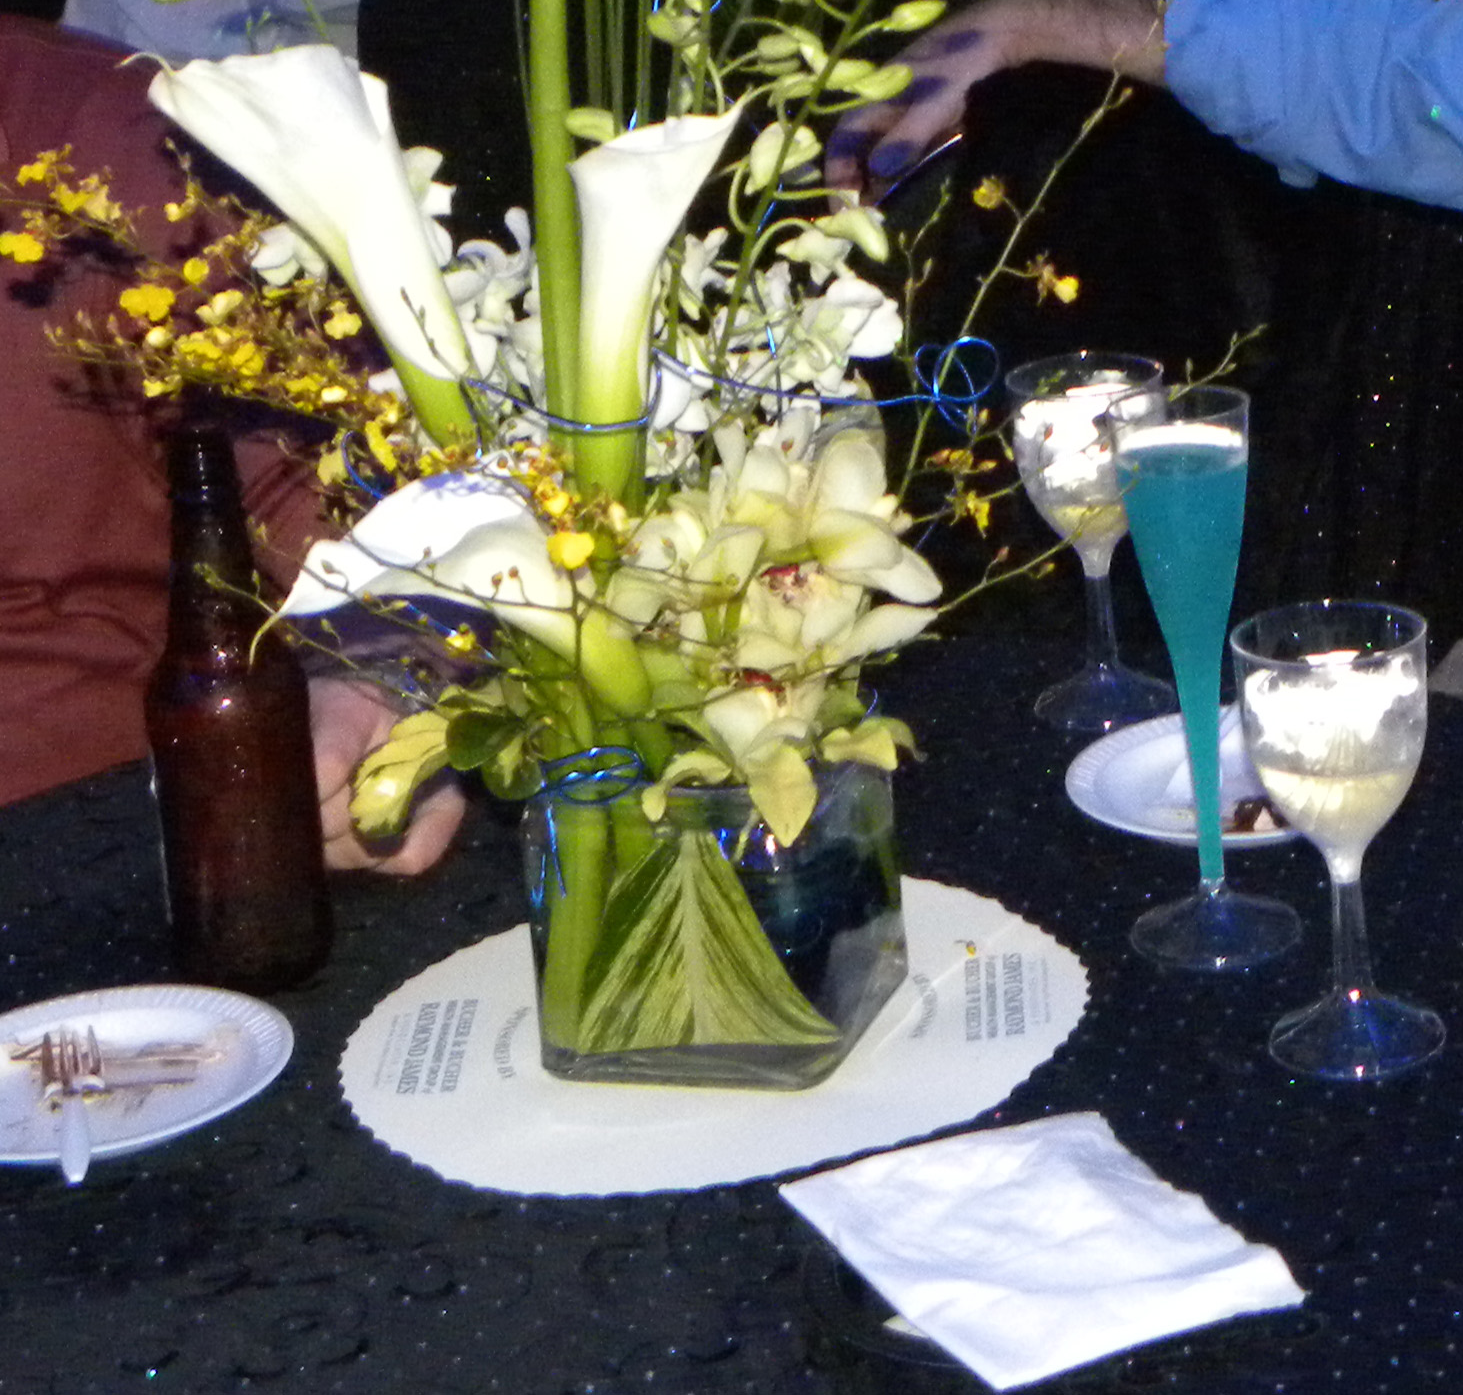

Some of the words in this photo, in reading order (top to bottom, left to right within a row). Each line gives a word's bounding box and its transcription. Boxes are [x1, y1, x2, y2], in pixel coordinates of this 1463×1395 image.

[408, 1002, 441, 1057] RAYMOND
[396, 1058, 425, 1095] JAMES
[440, 1049, 466, 1093] BUCHER
